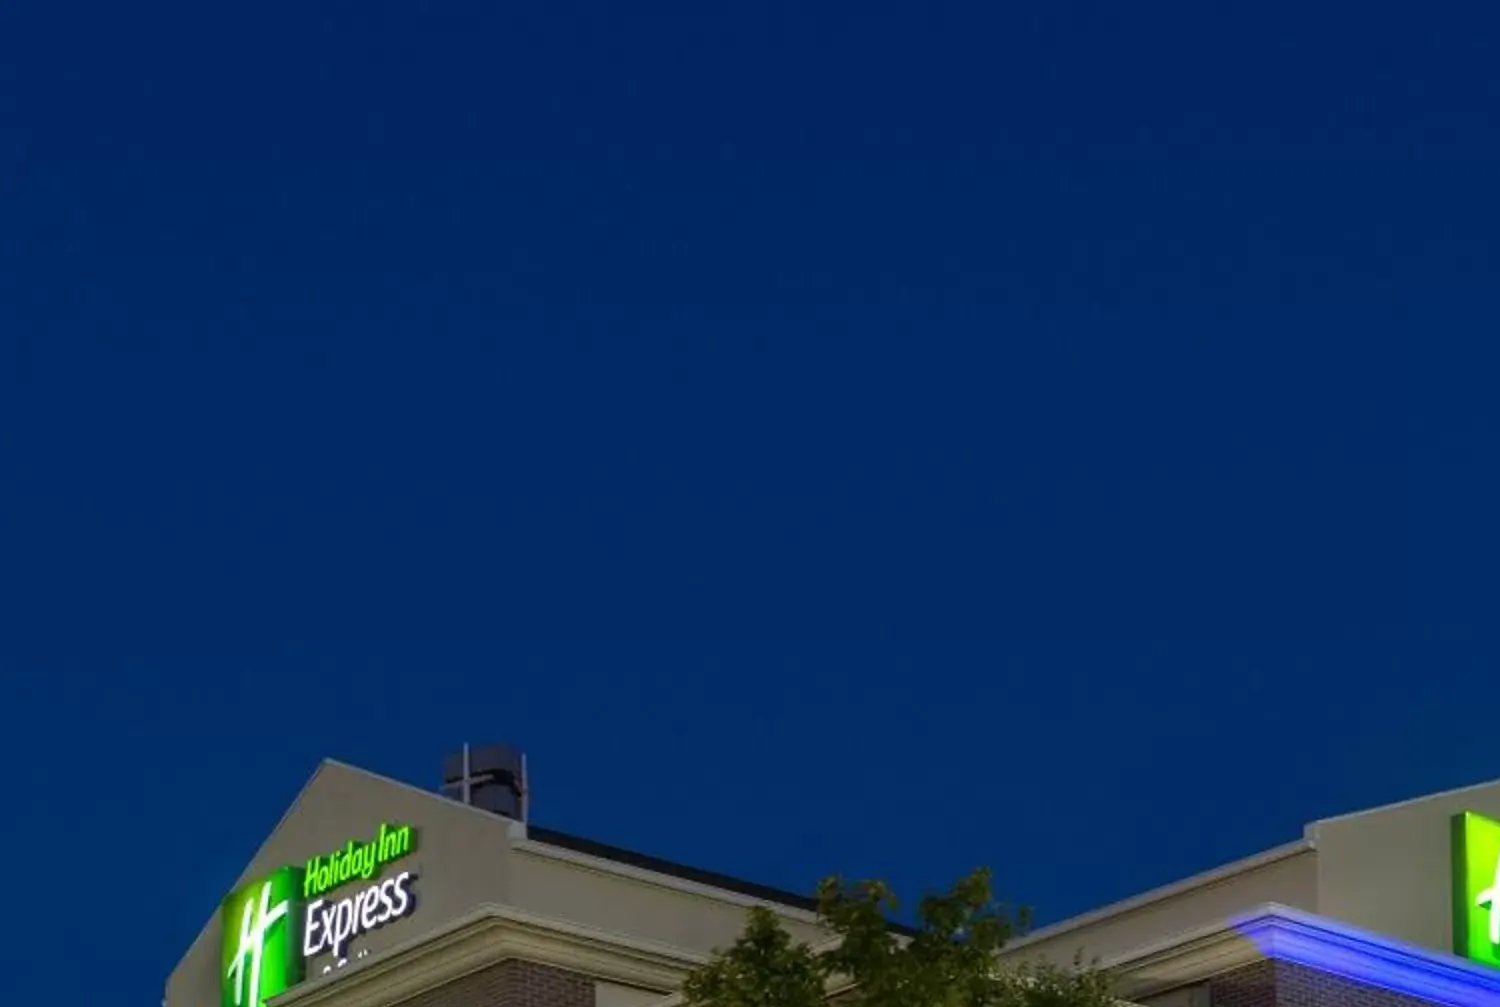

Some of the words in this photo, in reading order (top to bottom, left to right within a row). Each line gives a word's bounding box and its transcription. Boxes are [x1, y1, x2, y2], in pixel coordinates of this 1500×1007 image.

[304, 842, 376, 898] Holiday
[378, 823, 409, 862] Inn
[303, 871, 409, 957] Express
